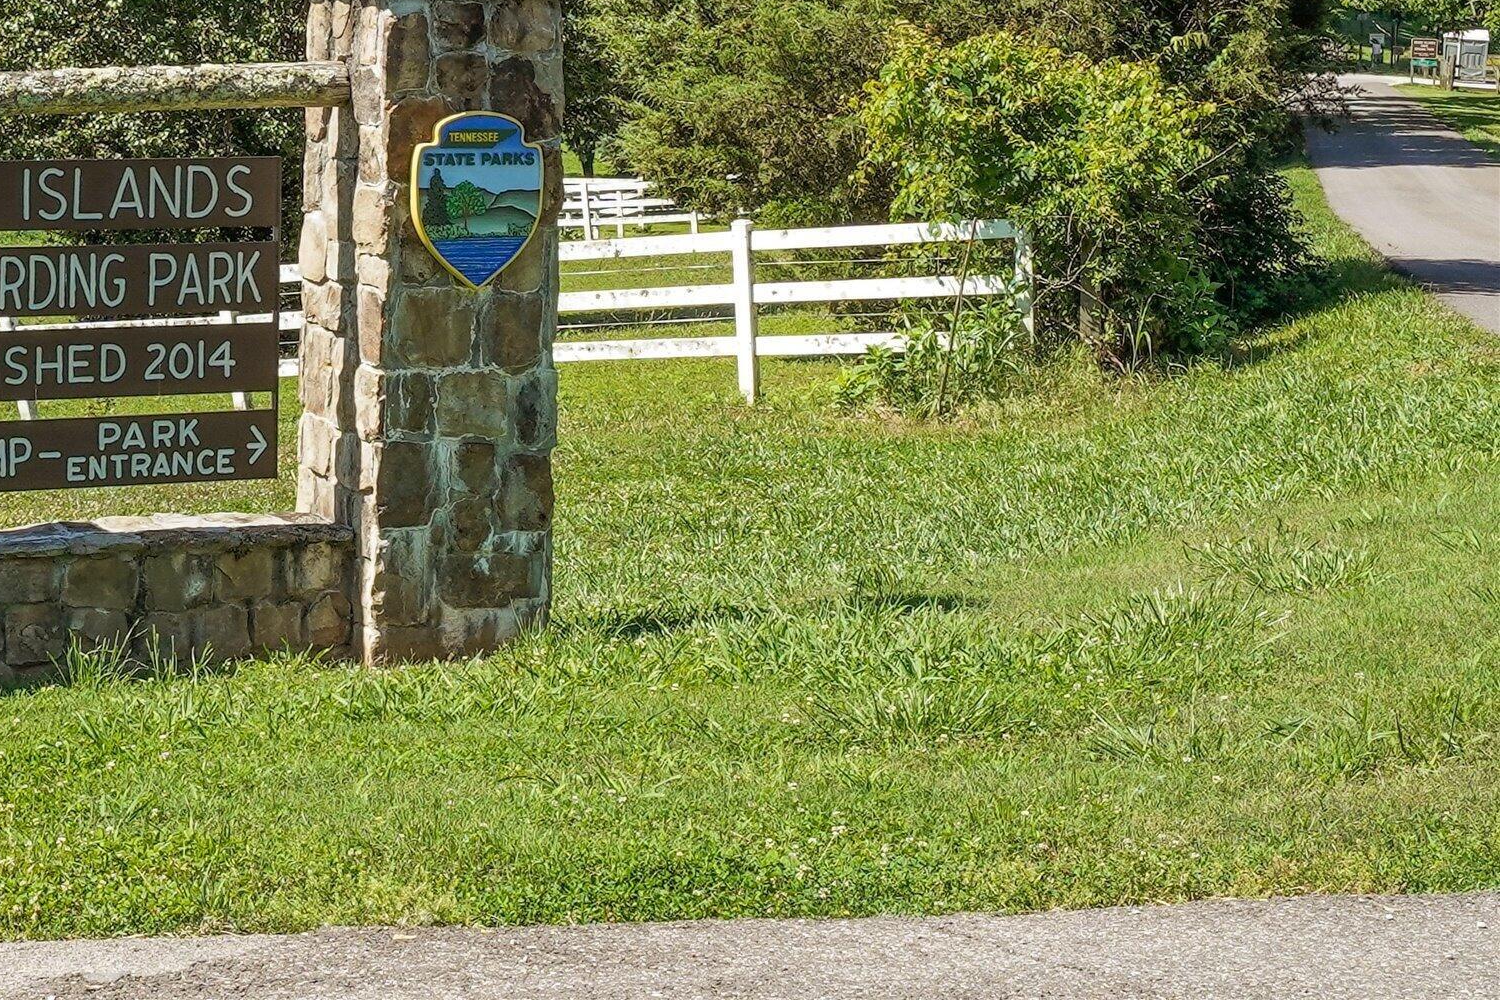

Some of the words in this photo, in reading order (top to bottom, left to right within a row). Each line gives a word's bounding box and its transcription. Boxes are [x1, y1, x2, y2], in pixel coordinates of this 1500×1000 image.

[449, 132, 499, 142] TENNESSEE
[423, 152, 475, 166] STATE
[481, 152, 535, 166] PARKS
[23, 163, 254, 221] ISLANDS
[148, 250, 262, 307] PARK
[144, 339, 237, 381] 2014
[98, 418, 200, 451] PARK
[66, 448, 236, 482] ENTRANCE
